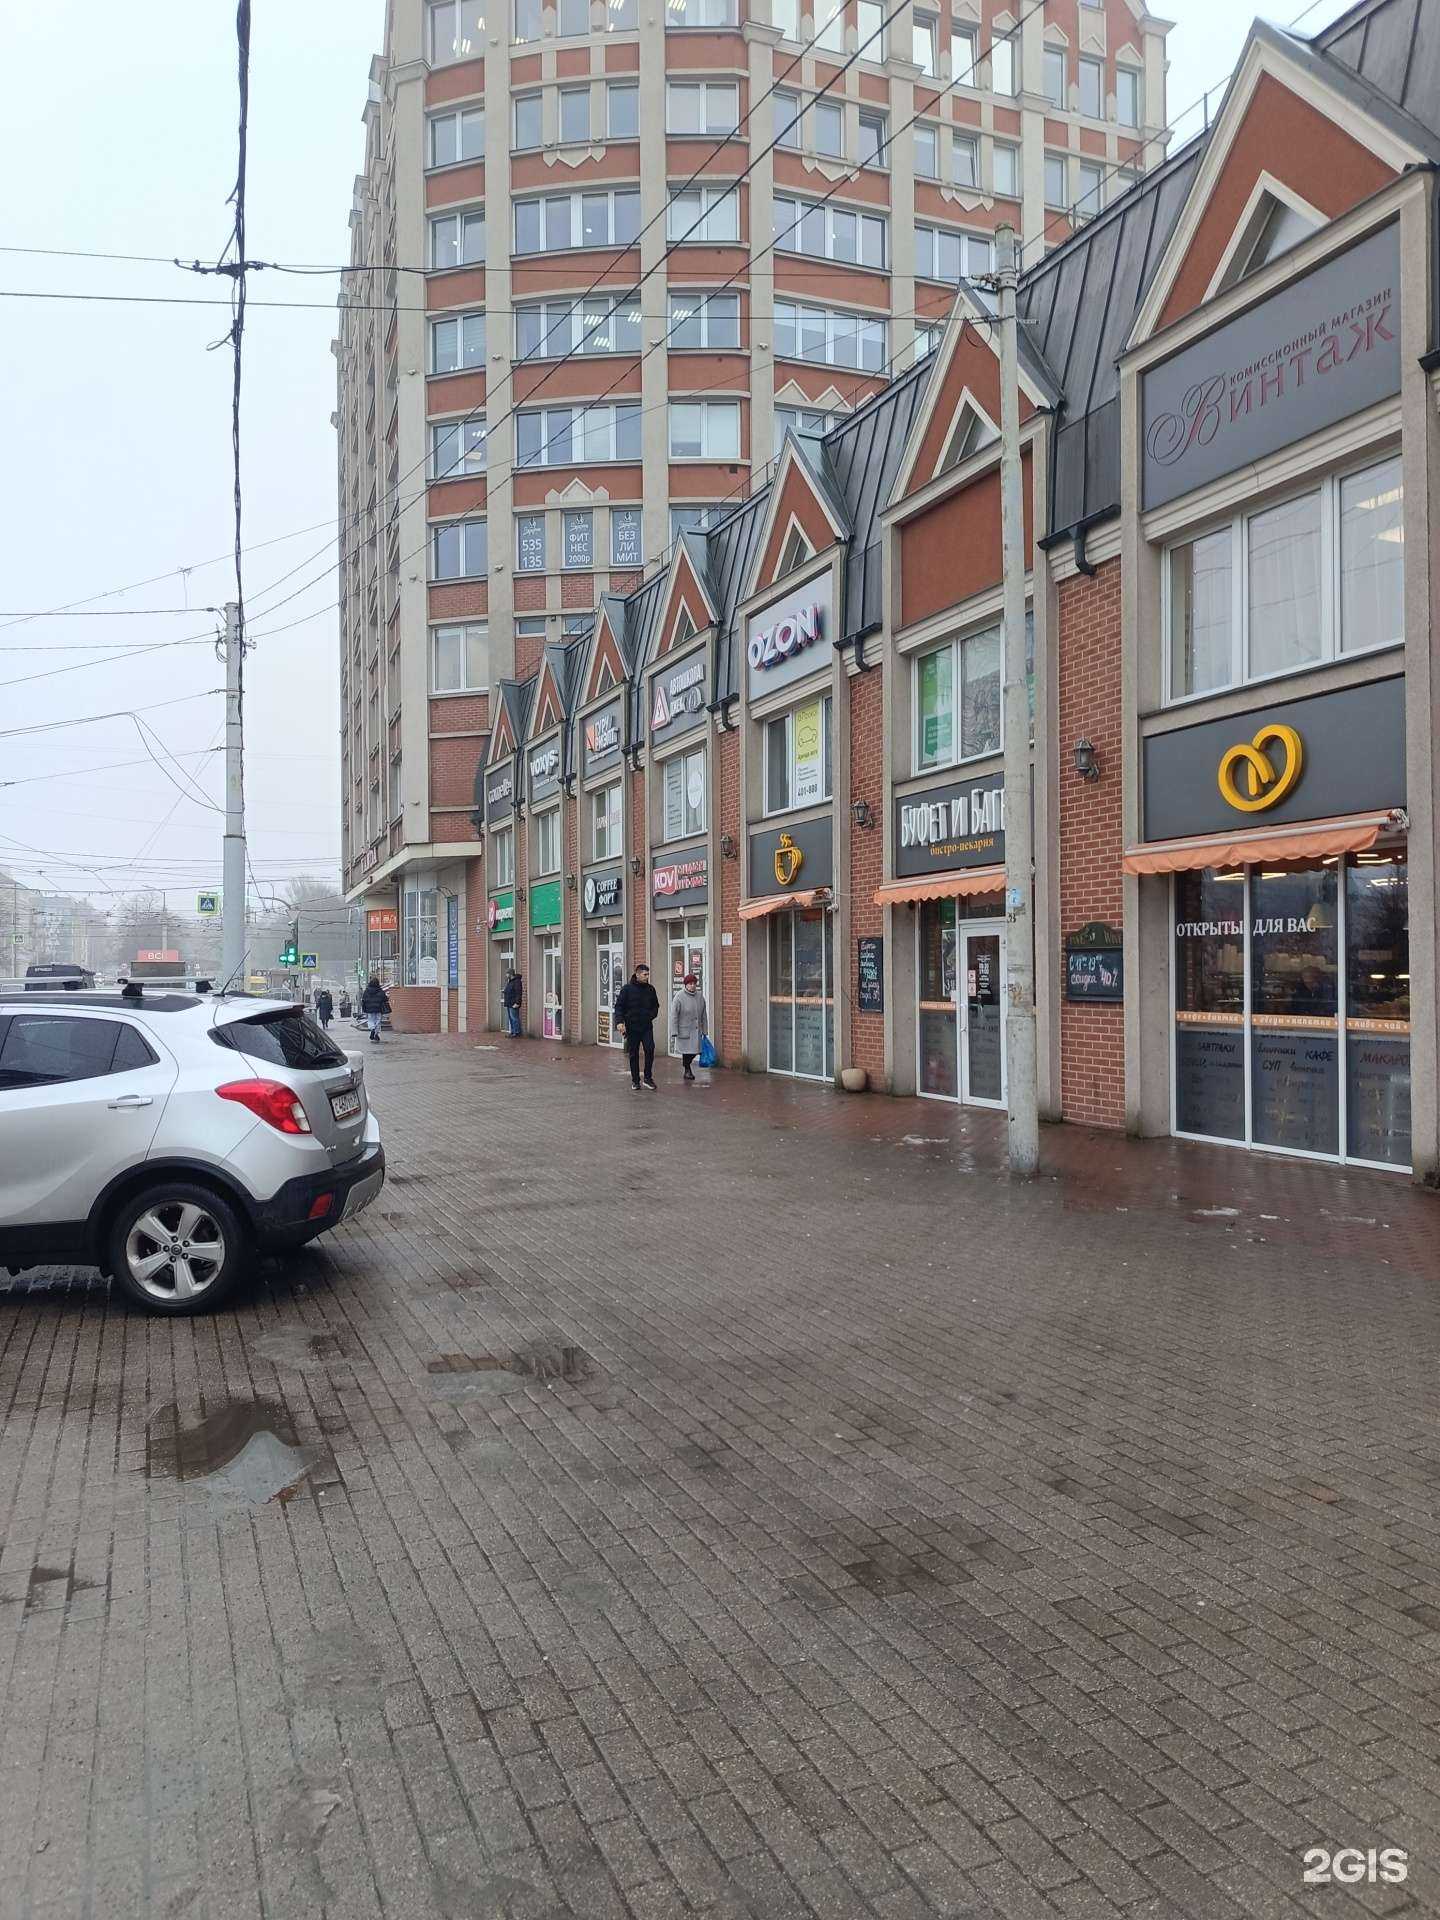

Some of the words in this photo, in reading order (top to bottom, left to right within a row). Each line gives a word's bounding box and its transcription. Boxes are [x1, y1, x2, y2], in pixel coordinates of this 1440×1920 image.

[1230, 322, 1326, 386] КОМИССИОННЫЙ
[1331, 288, 1392, 330] МАГАЗИН
[569, 533, 589, 543] ФИТ
[618, 531, 636, 541] БЕЗ
[522, 538, 542, 551] 535
[570, 544, 588, 552] НЕС
[619, 542, 634, 552] ЛИ
[522, 556, 542, 568] 135
[616, 552, 639, 562] МИТ
[748, 605, 820, 671] OZON
[901, 801, 949, 847] БУФЕТ
[951, 796, 968, 838] И
[596, 877, 618, 893] COFFEE
[654, 870, 675, 890] KDV
[598, 891, 615, 905] ФОРТ
[1177, 920, 1244, 937] ОТКРЫТЫ
[1253, 918, 1284, 936] ДЛЯ
[1286, 917, 1316, 933] ВАС
